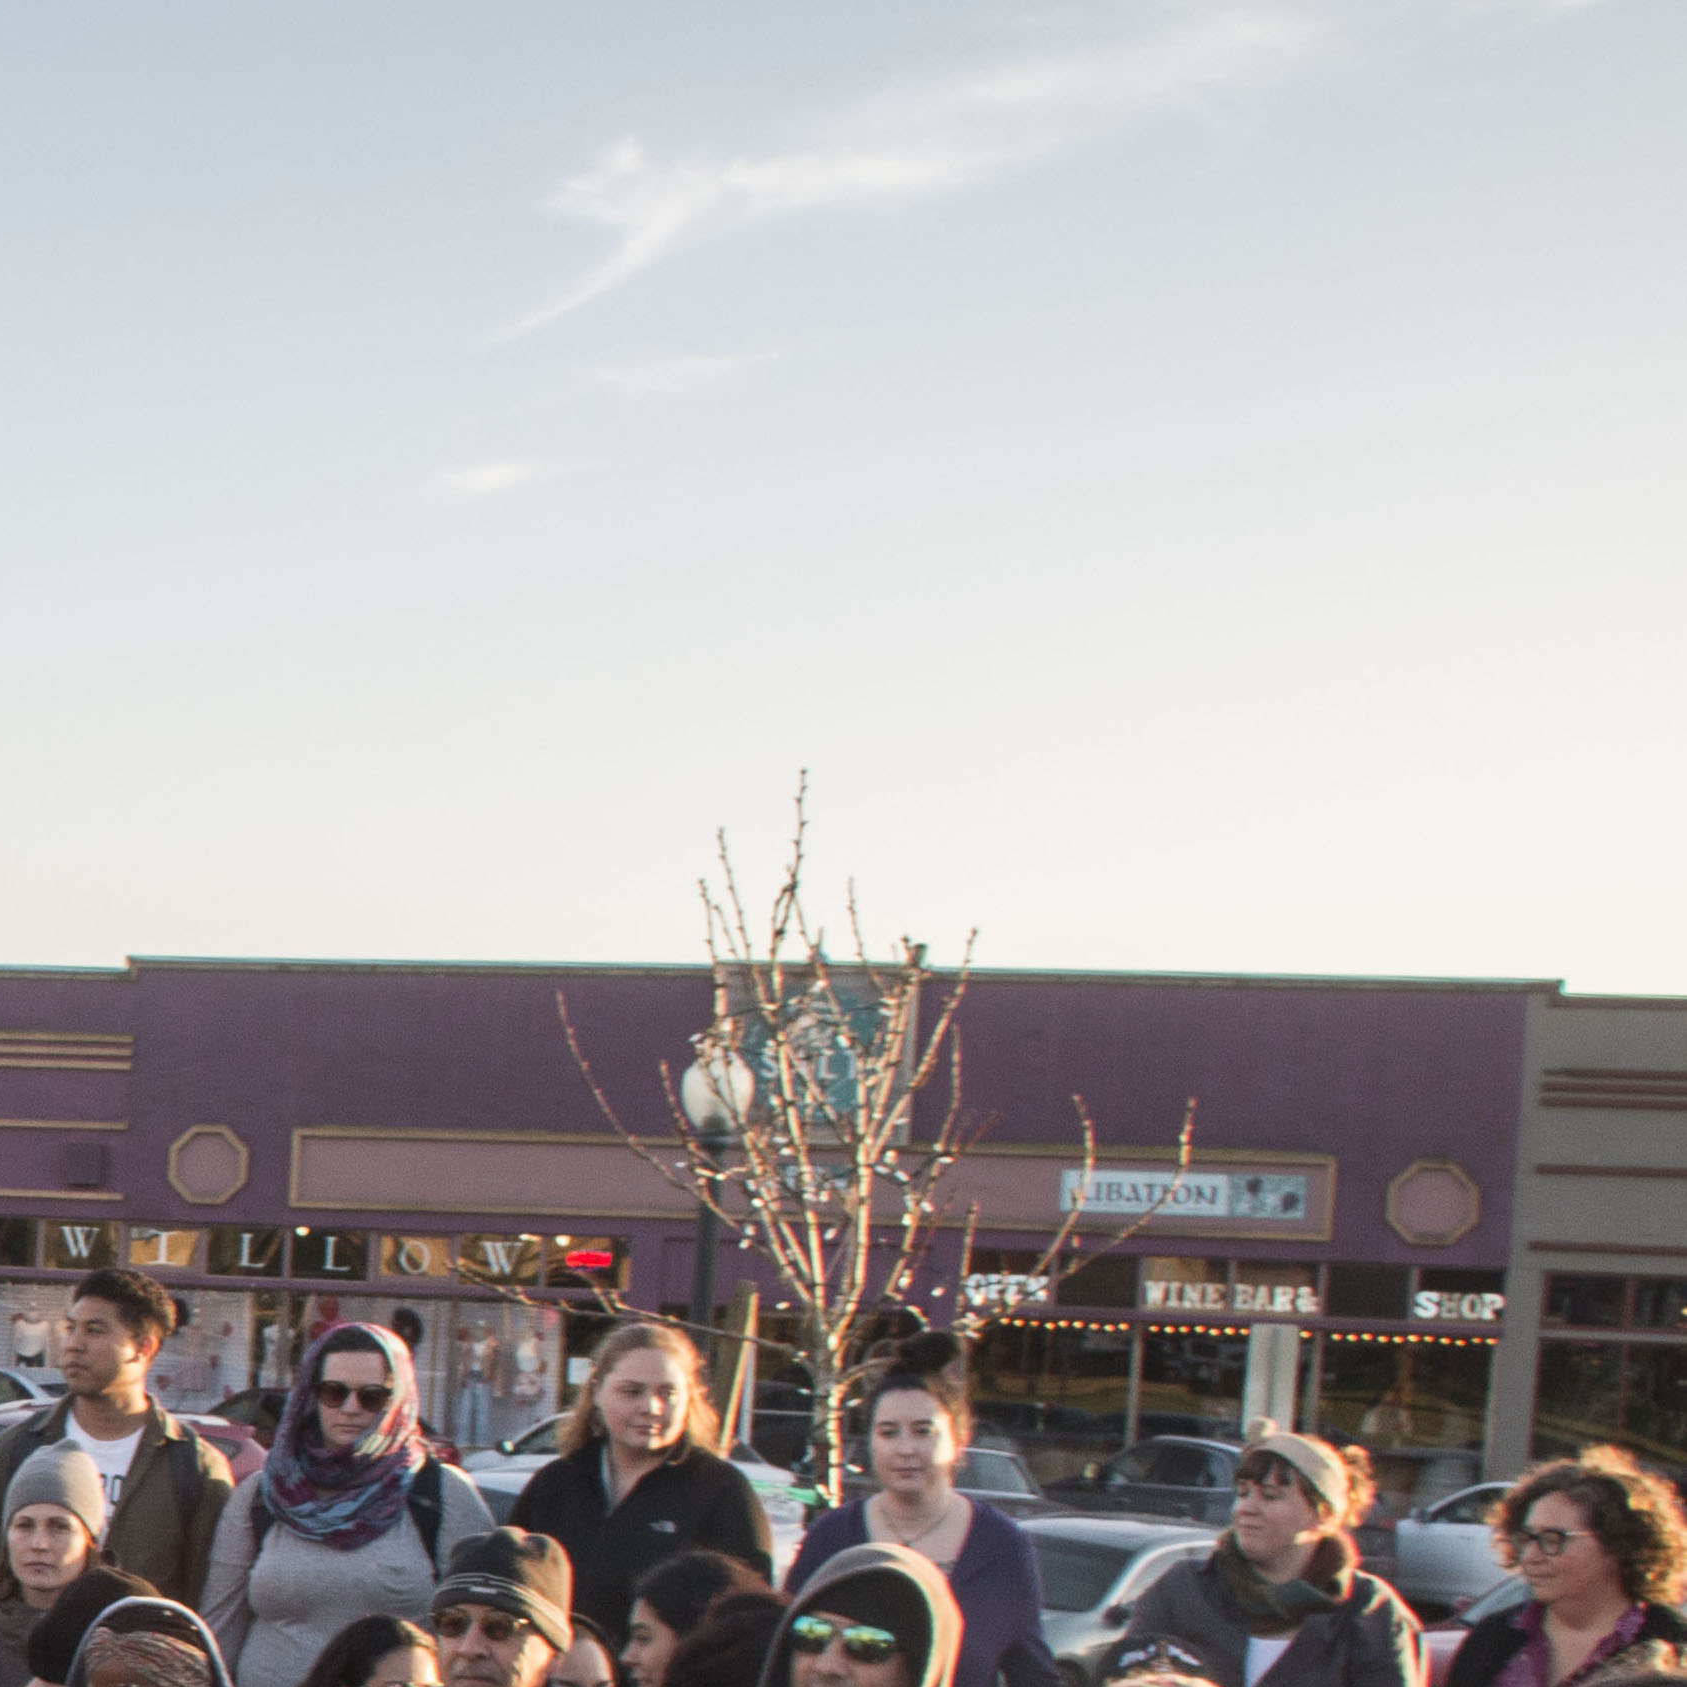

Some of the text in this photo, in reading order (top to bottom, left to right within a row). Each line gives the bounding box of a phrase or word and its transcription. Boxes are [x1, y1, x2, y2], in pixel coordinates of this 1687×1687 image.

[59, 1225, 524, 1277] WILLOW
[1144, 1280, 1226, 1311] WINE
[1413, 1290, 1505, 1320] SHOP
